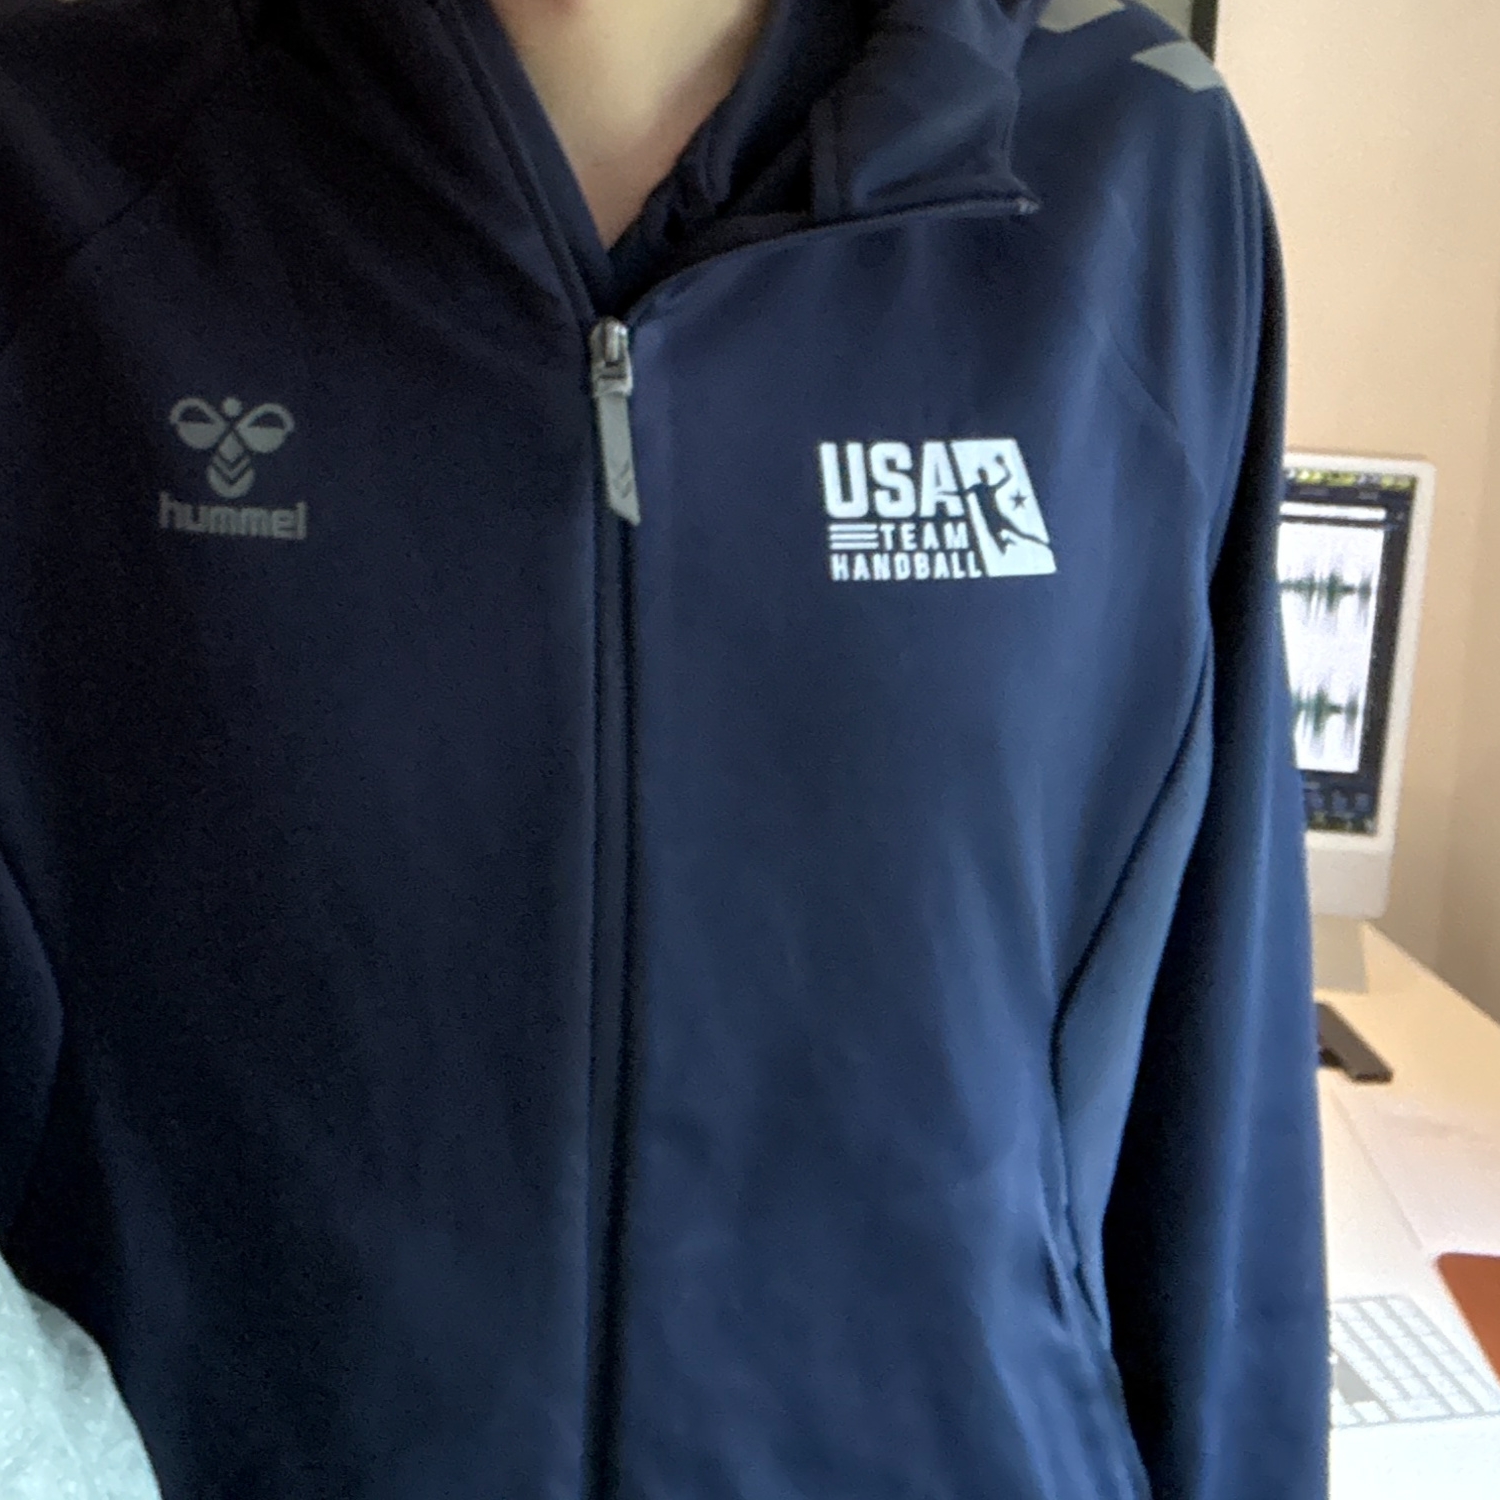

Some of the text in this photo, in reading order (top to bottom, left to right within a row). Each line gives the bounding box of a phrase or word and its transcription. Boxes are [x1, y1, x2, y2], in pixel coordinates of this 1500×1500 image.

[820, 442, 965, 518] USA
[159, 492, 307, 540] hummel
[880, 522, 969, 551] TEAM
[831, 551, 982, 581] HANDBALL
